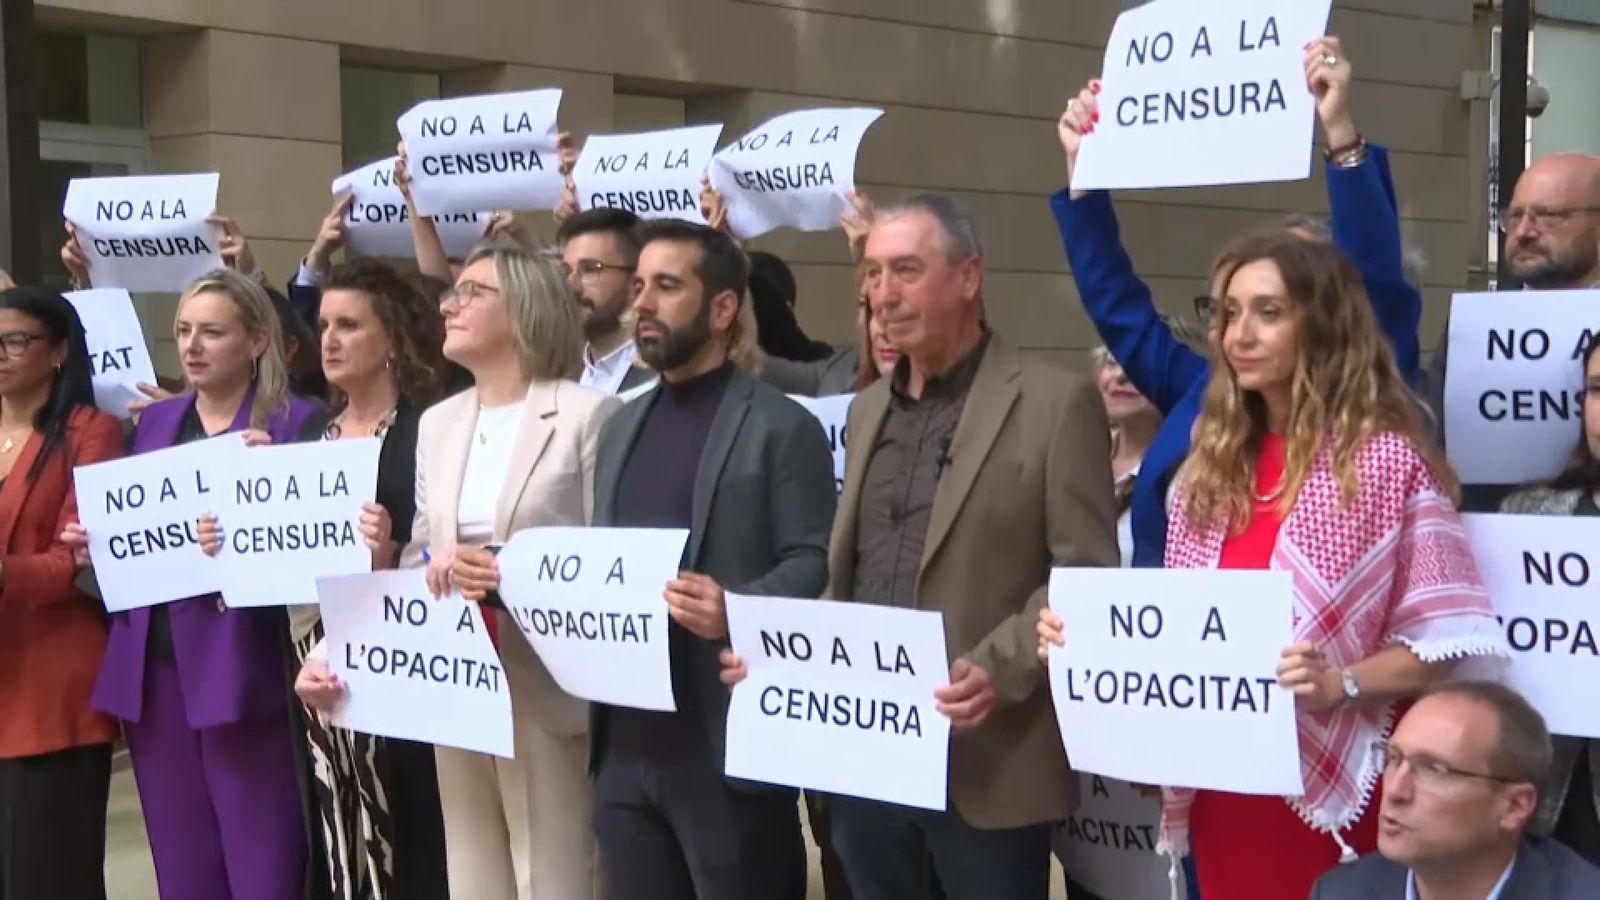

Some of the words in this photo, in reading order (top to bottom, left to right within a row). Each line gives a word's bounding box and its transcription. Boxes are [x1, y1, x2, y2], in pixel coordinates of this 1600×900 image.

[1126, 32, 1174, 67] NO
[1190, 26, 1212, 58] A
[1239, 16, 1280, 51] LA
[1116, 79, 1286, 126] CENSURA
[421, 116, 456, 137] NO
[469, 115, 485, 135] A
[503, 112, 532, 134] LA
[776, 130, 793, 148] A
[809, 124, 839, 144] LA
[422, 149, 544, 176] CENSURA
[594, 154, 627, 174] NO
[634, 152, 648, 171] A
[664, 149, 689, 170] LA
[732, 161, 834, 192] CENSURA
[95, 200, 133, 221] NO
[141, 199, 155, 220] A
[160, 198, 187, 220] LA
[591, 188, 697, 213] CENSURA
[94, 235, 211, 258] CENSURA
[1487, 328, 1550, 360] NO
[1570, 328, 1592, 360] A
[105, 484, 146, 514] NO
[160, 477, 177, 502] A
[195, 470, 210, 494] L
[236, 477, 272, 504] NO
[284, 475, 300, 500] A
[319, 470, 349, 497] LA
[233, 520, 356, 554] CENSURA
[538, 554, 582, 582] NO
[605, 556, 625, 585] A
[1522, 551, 1590, 587] NO
[384, 595, 428, 626] NO
[456, 605, 475, 633] A
[513, 606, 653, 643] L'OPACITAT
[1110, 604, 1163, 639] NO
[1201, 606, 1226, 641] A
[346, 643, 500, 693] L'OPACITAT
[760, 629, 812, 661] NO
[831, 636, 852, 667] A
[874, 641, 915, 676] LA
[1067, 668, 1277, 713] L'OPACITAT
[759, 685, 922, 737] CENSURA
